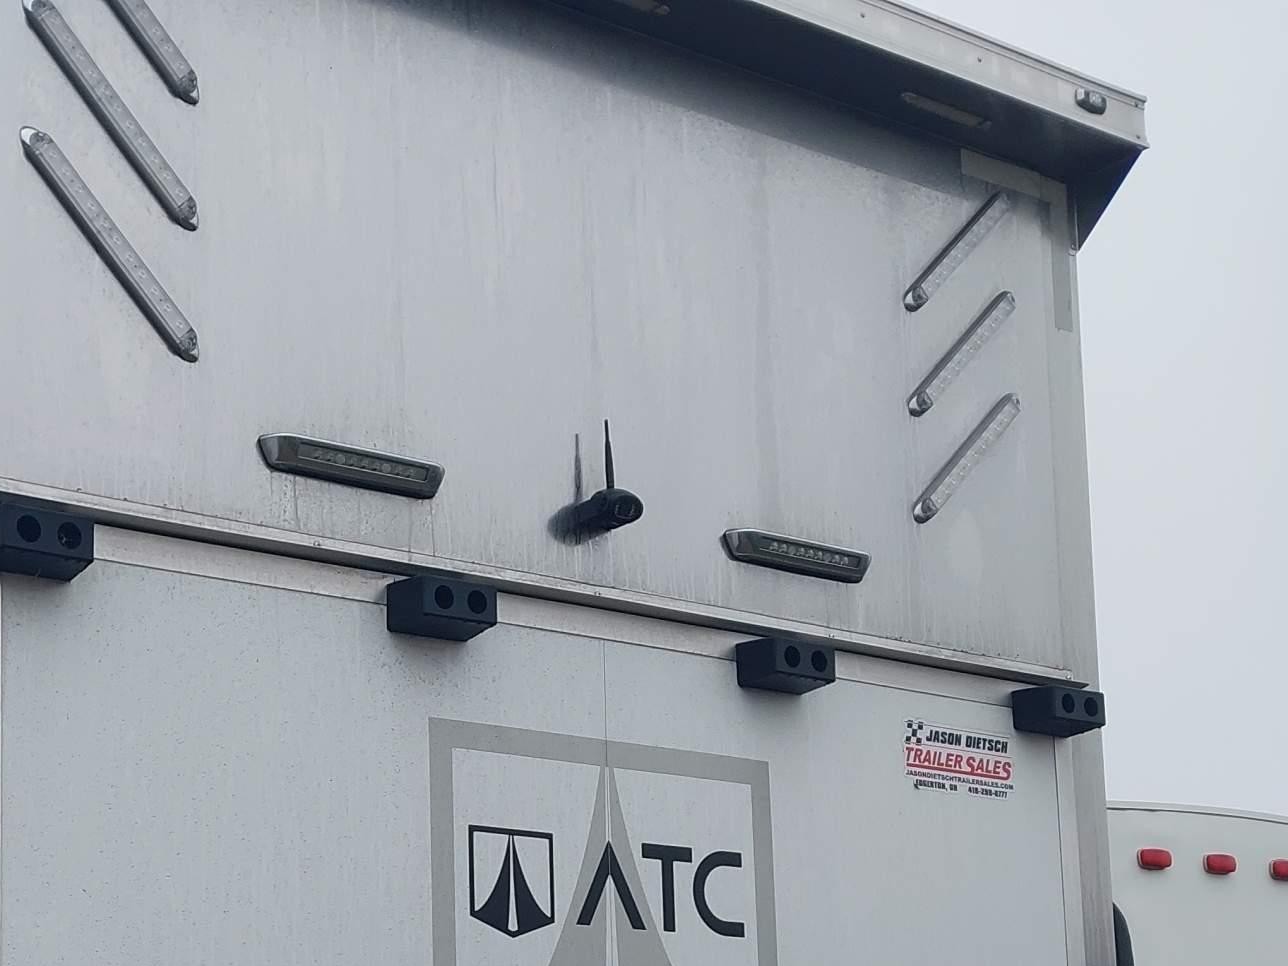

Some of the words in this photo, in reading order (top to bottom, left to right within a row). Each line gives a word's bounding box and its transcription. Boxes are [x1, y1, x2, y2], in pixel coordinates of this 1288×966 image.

[926, 729, 962, 747] JASON
[965, 734, 1009, 754] DIETSCH
[905, 746, 964, 770] TRAILER
[966, 756, 1012, 780] SALES
[575, 840, 746, 938] ATC
